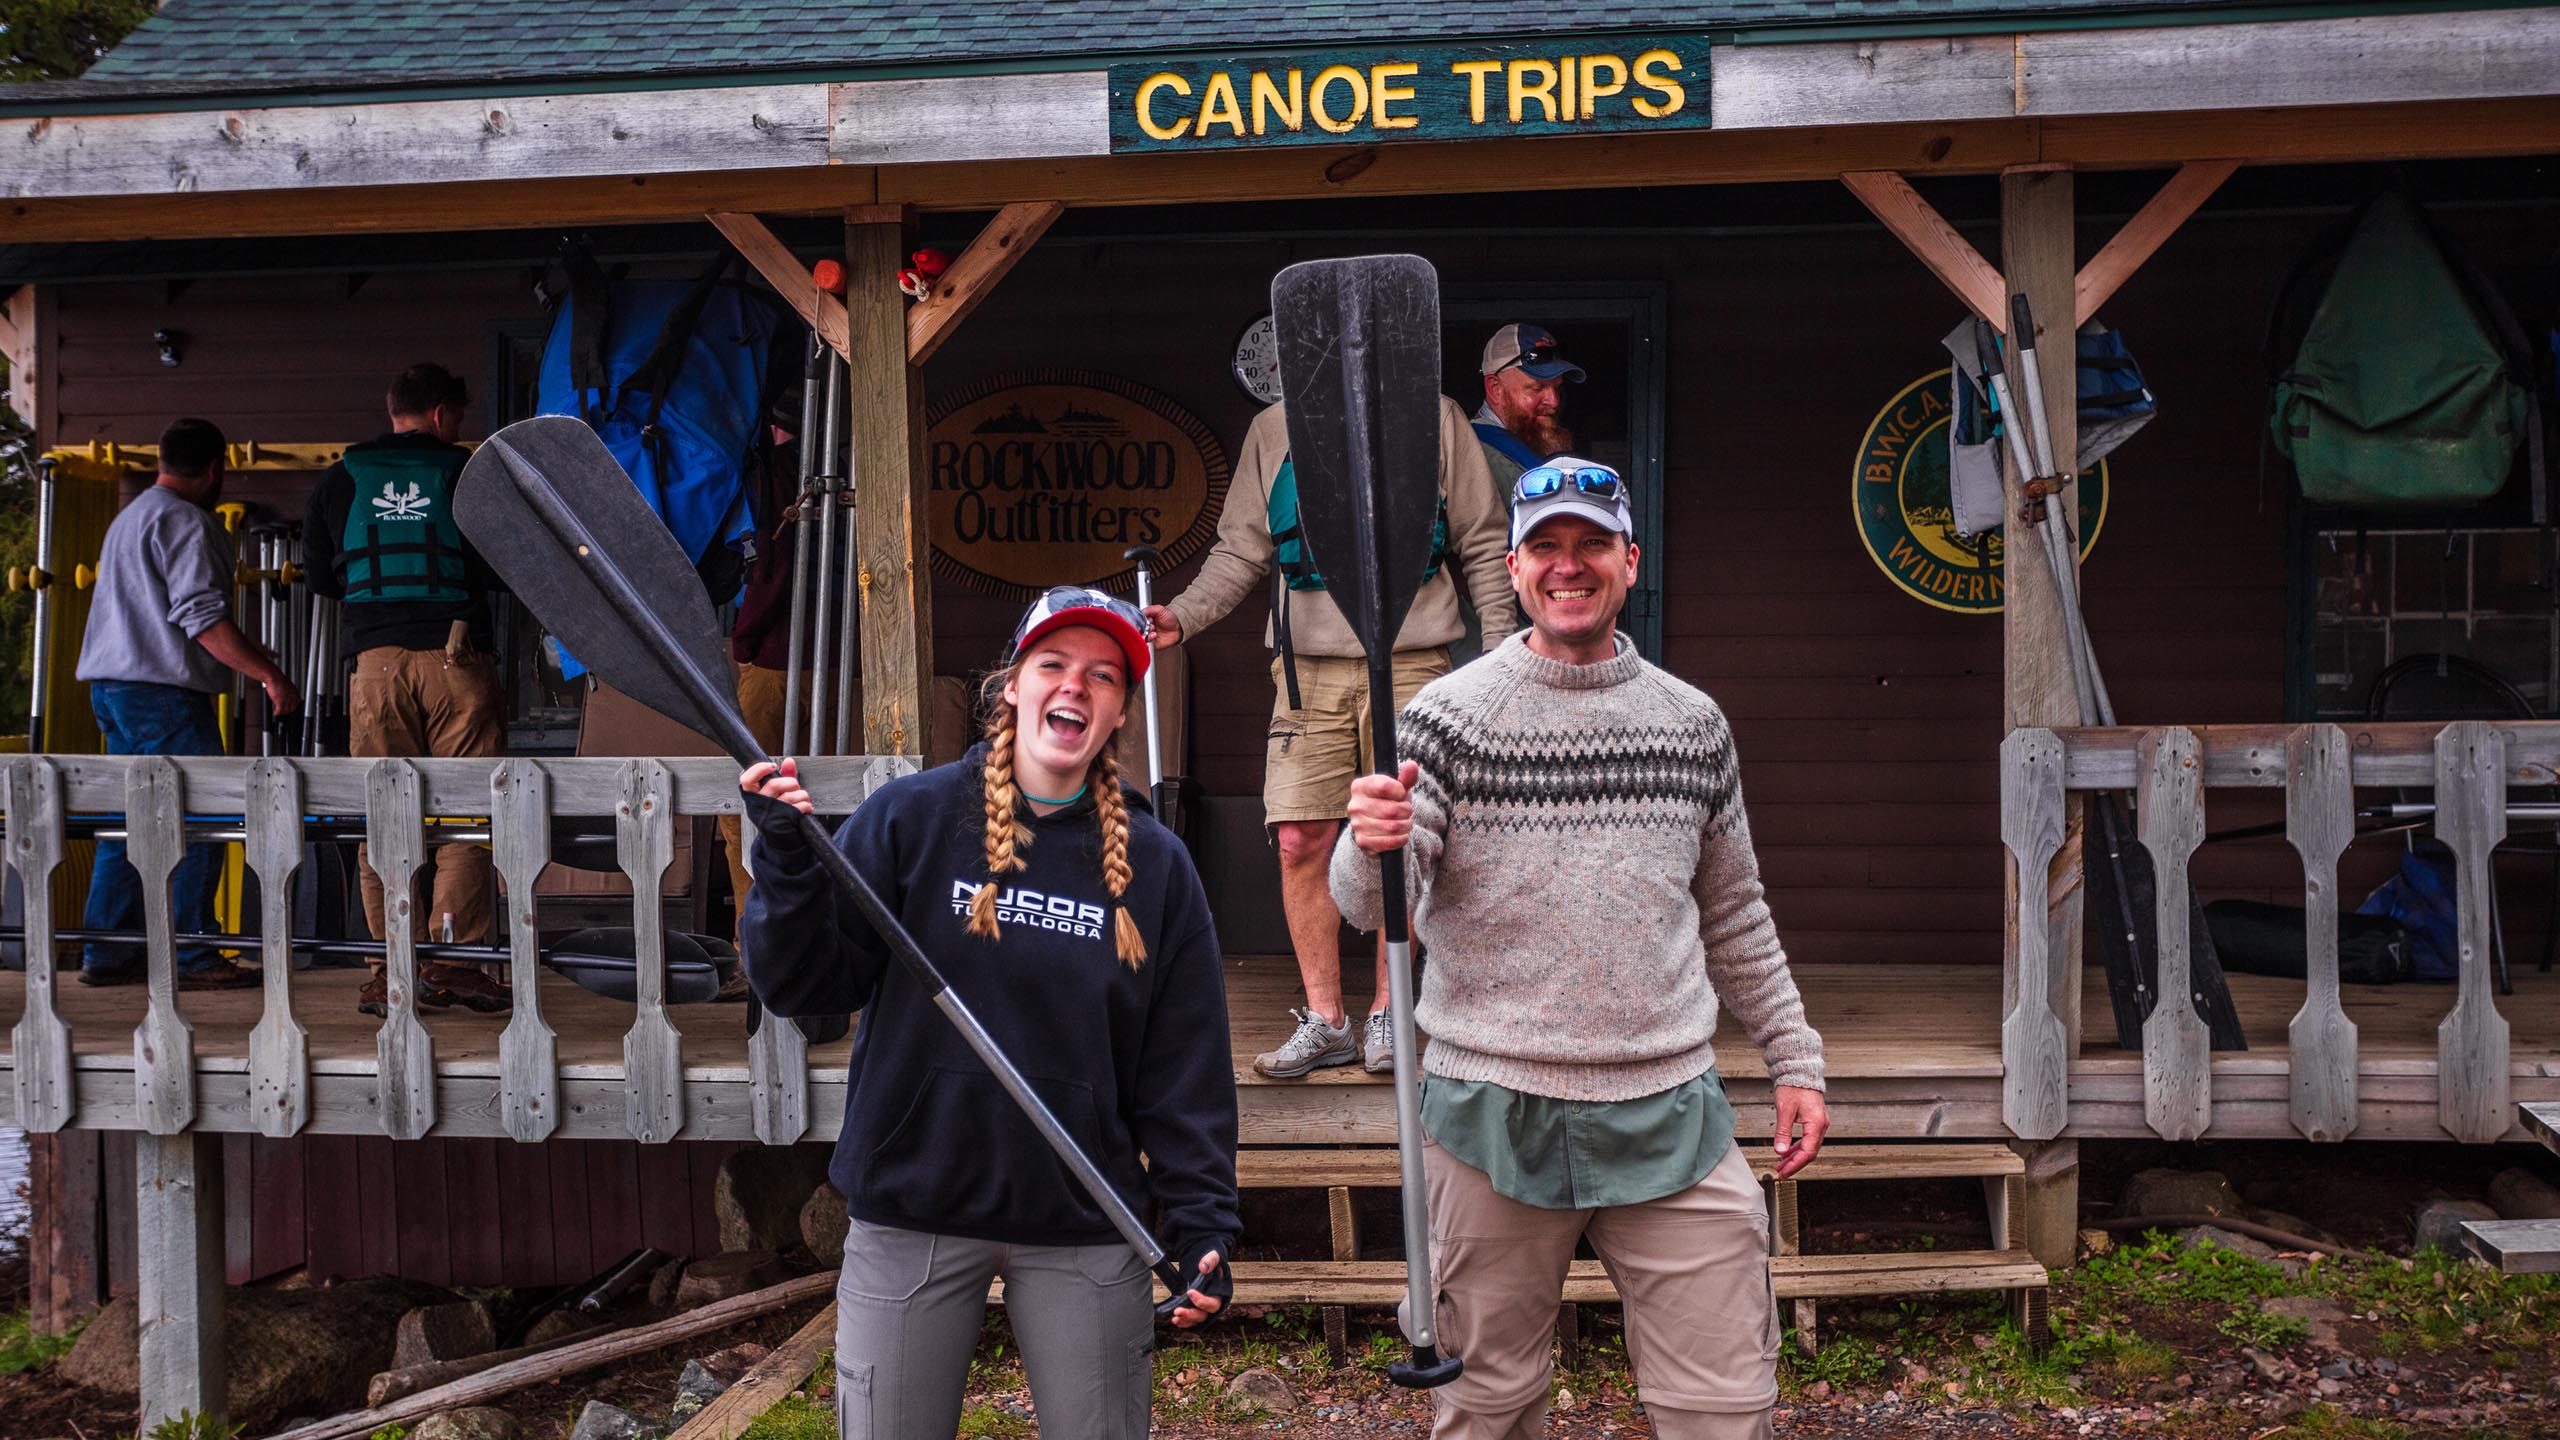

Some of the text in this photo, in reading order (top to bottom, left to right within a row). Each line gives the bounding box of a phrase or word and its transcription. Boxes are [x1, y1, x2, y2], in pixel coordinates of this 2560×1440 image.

[1135, 49, 1686, 140] CANOE TRIPS
[1251, 332, 1260, 344] 0
[930, 440, 1176, 492] ROCKWOOD
[954, 489, 1162, 545] Outfitters
[952, 903, 1101, 940] TUCALOOSA
